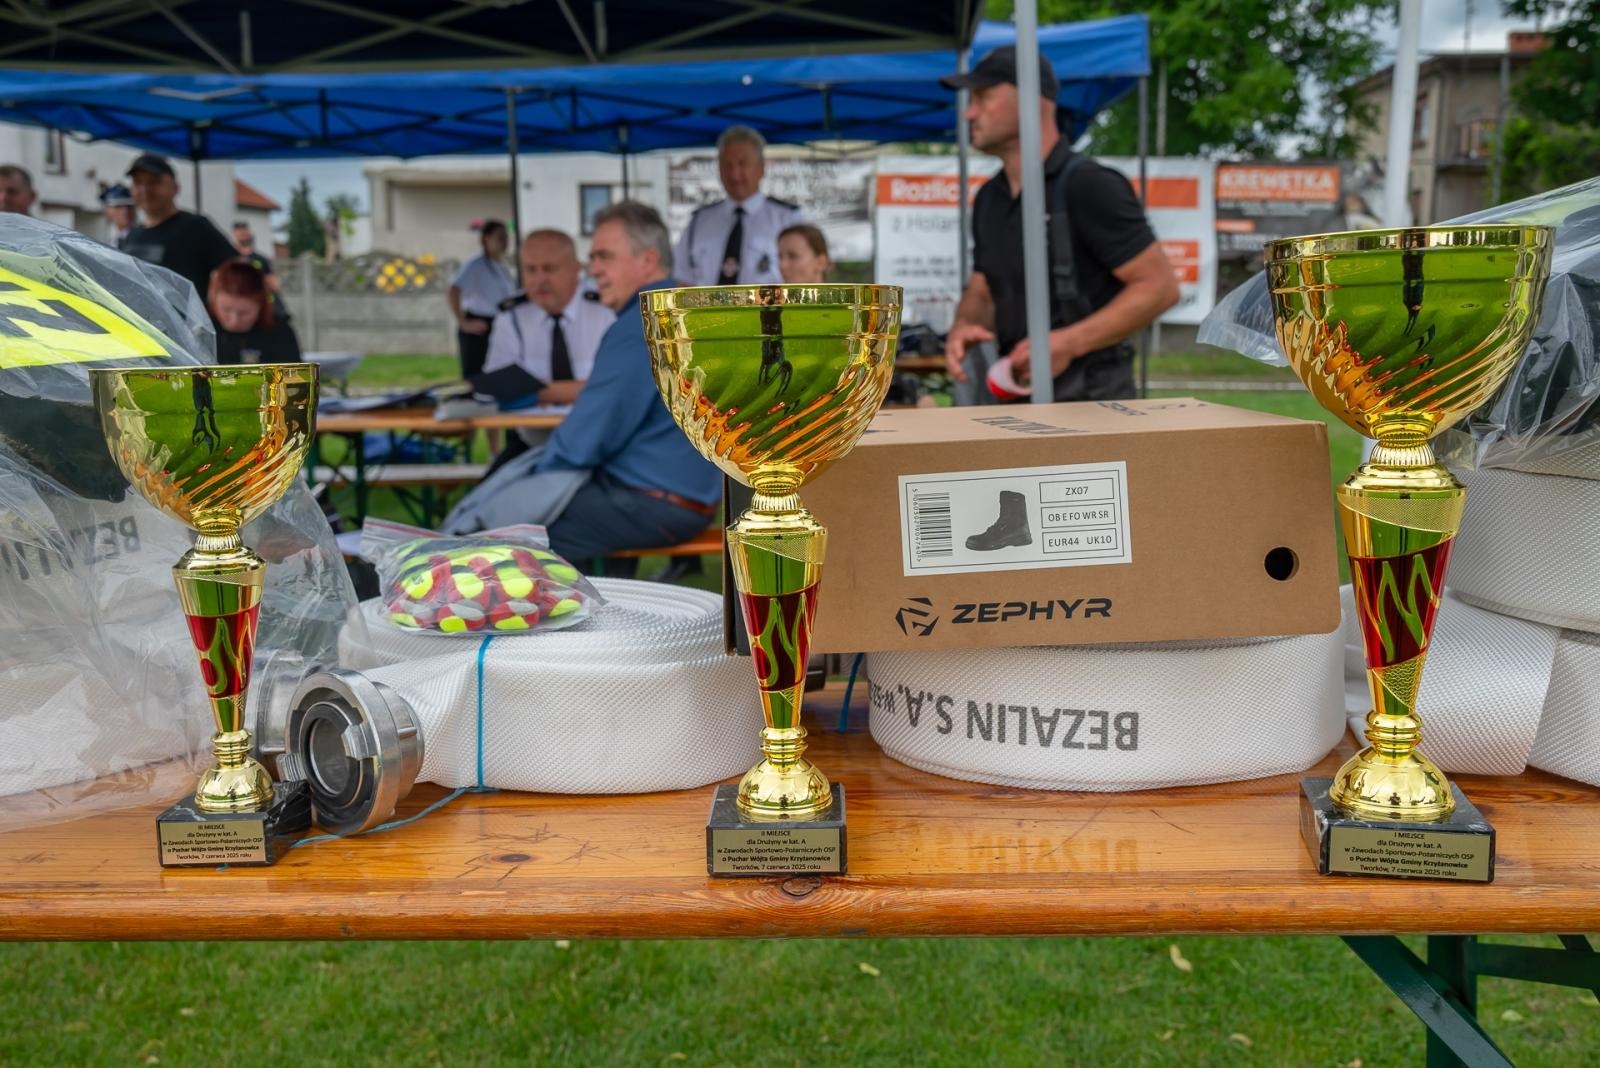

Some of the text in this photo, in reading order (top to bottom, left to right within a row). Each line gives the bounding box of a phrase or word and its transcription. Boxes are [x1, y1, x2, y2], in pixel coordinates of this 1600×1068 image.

[1219, 169, 1333, 189] KREWETKA
[1065, 486, 1089, 496] ZX07
[1048, 510, 1109, 522] OB E FO WR SR
[1048, 535, 1112, 547] EUR44 UK10
[951, 597, 1113, 624] ZEPHYR
[898, 684, 954, 735] S.A.
[966, 700, 1140, 751] BEZALIN
[1398, 832, 1424, 840] MIEJSCE
[1351, 846, 1384, 855] Zawodach
[1423, 841, 1435, 849] kat.
[750, 855, 768, 863] Wójta
[1355, 855, 1378, 863] Puchar
[1379, 857, 1399, 865] Wójta
[1400, 858, 1422, 867] Gminy
[1424, 868, 1441, 876] 2025
